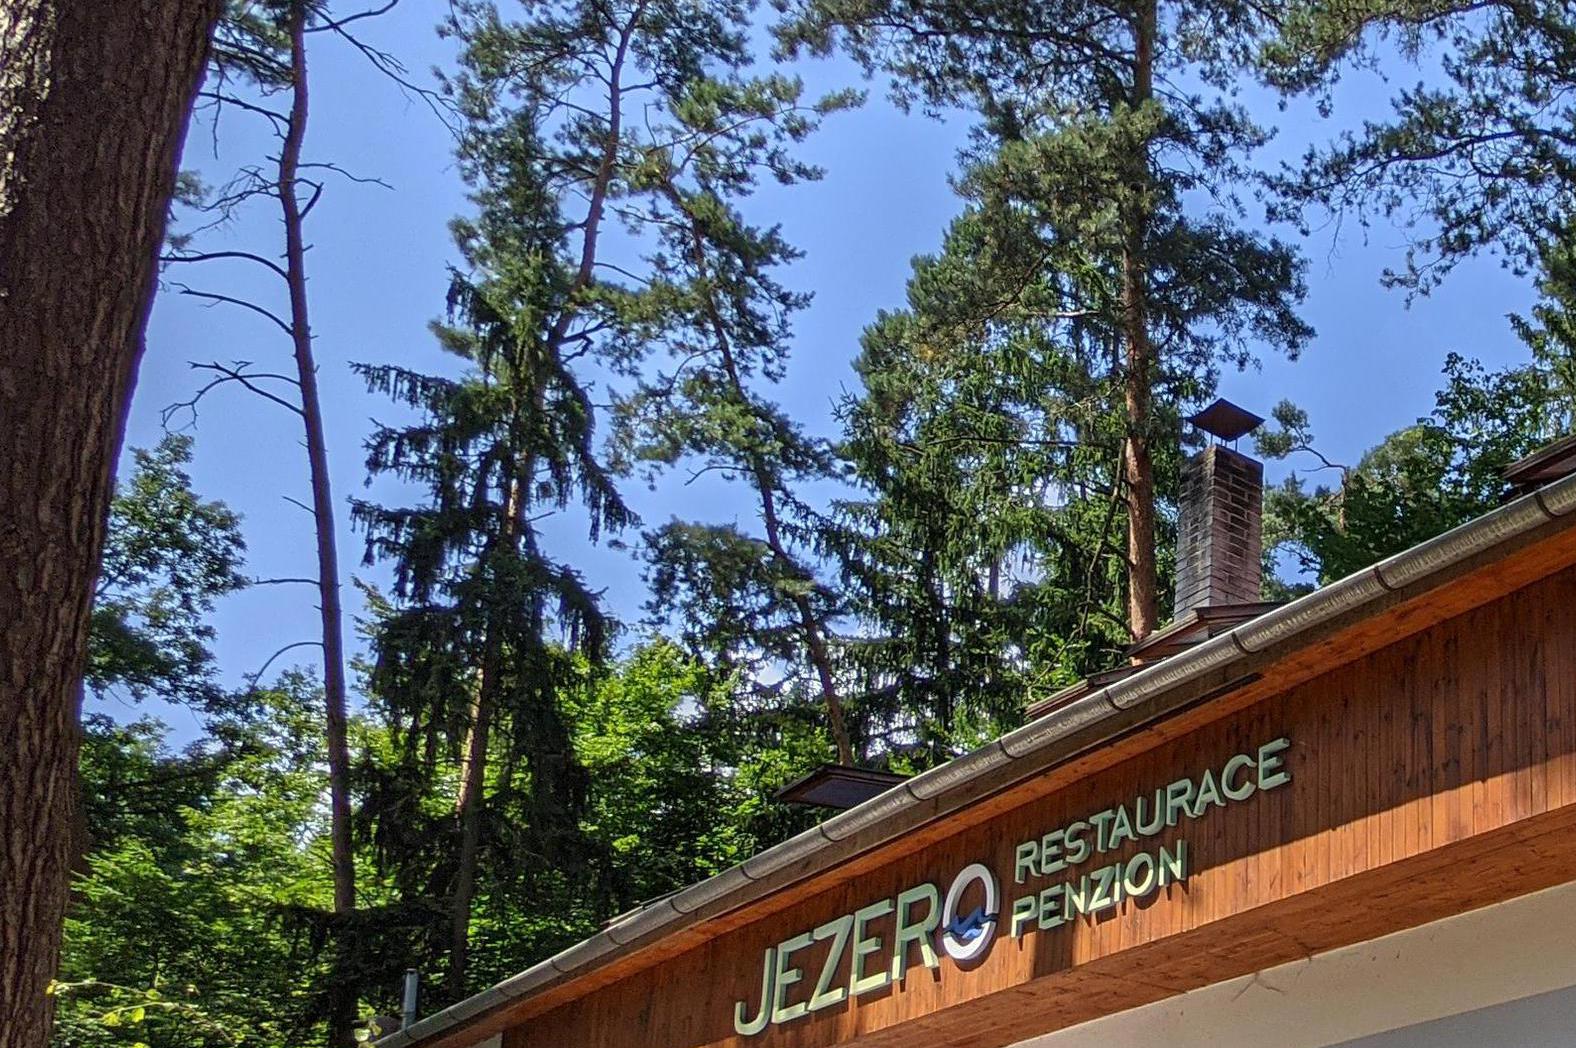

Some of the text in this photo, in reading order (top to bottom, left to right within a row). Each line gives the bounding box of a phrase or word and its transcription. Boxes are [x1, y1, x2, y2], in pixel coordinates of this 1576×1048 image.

[1014, 737, 1292, 885] RESTAURACE
[733, 862, 999, 1037] JEZERO
[1010, 839, 1188, 939] PENZION
